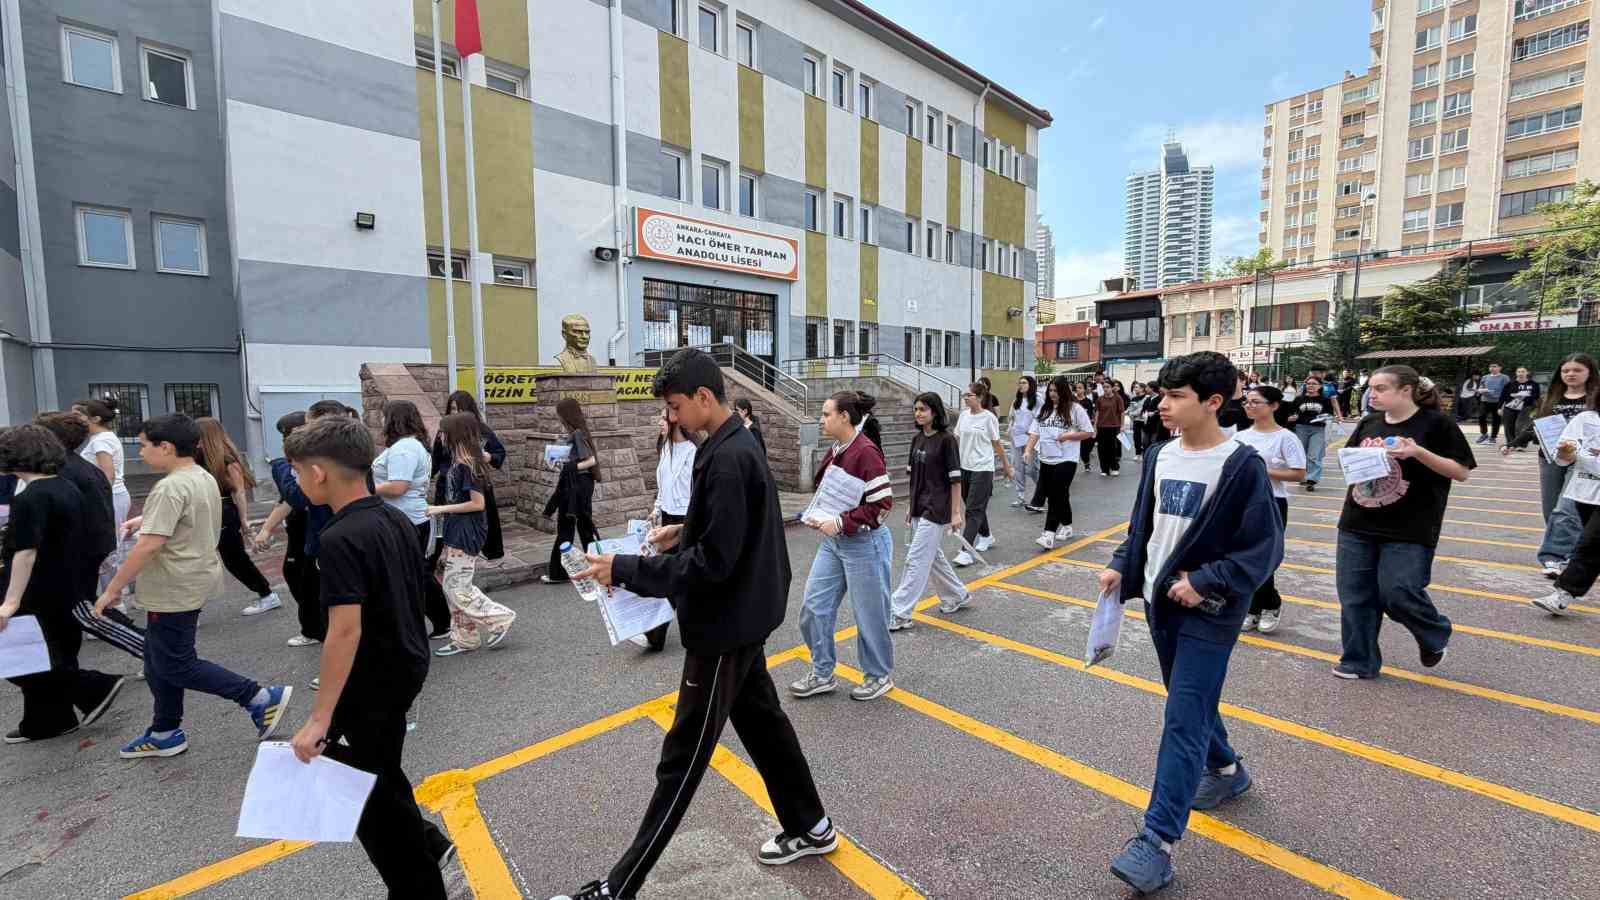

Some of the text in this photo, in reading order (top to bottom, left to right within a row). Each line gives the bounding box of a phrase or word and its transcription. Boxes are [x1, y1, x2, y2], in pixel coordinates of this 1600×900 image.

[677, 233, 787, 261] HACI ÖMER TARMAN
[677, 246, 762, 268] ANADOLU LİSESİ
[484, 373, 536, 384] ÖĞRET
